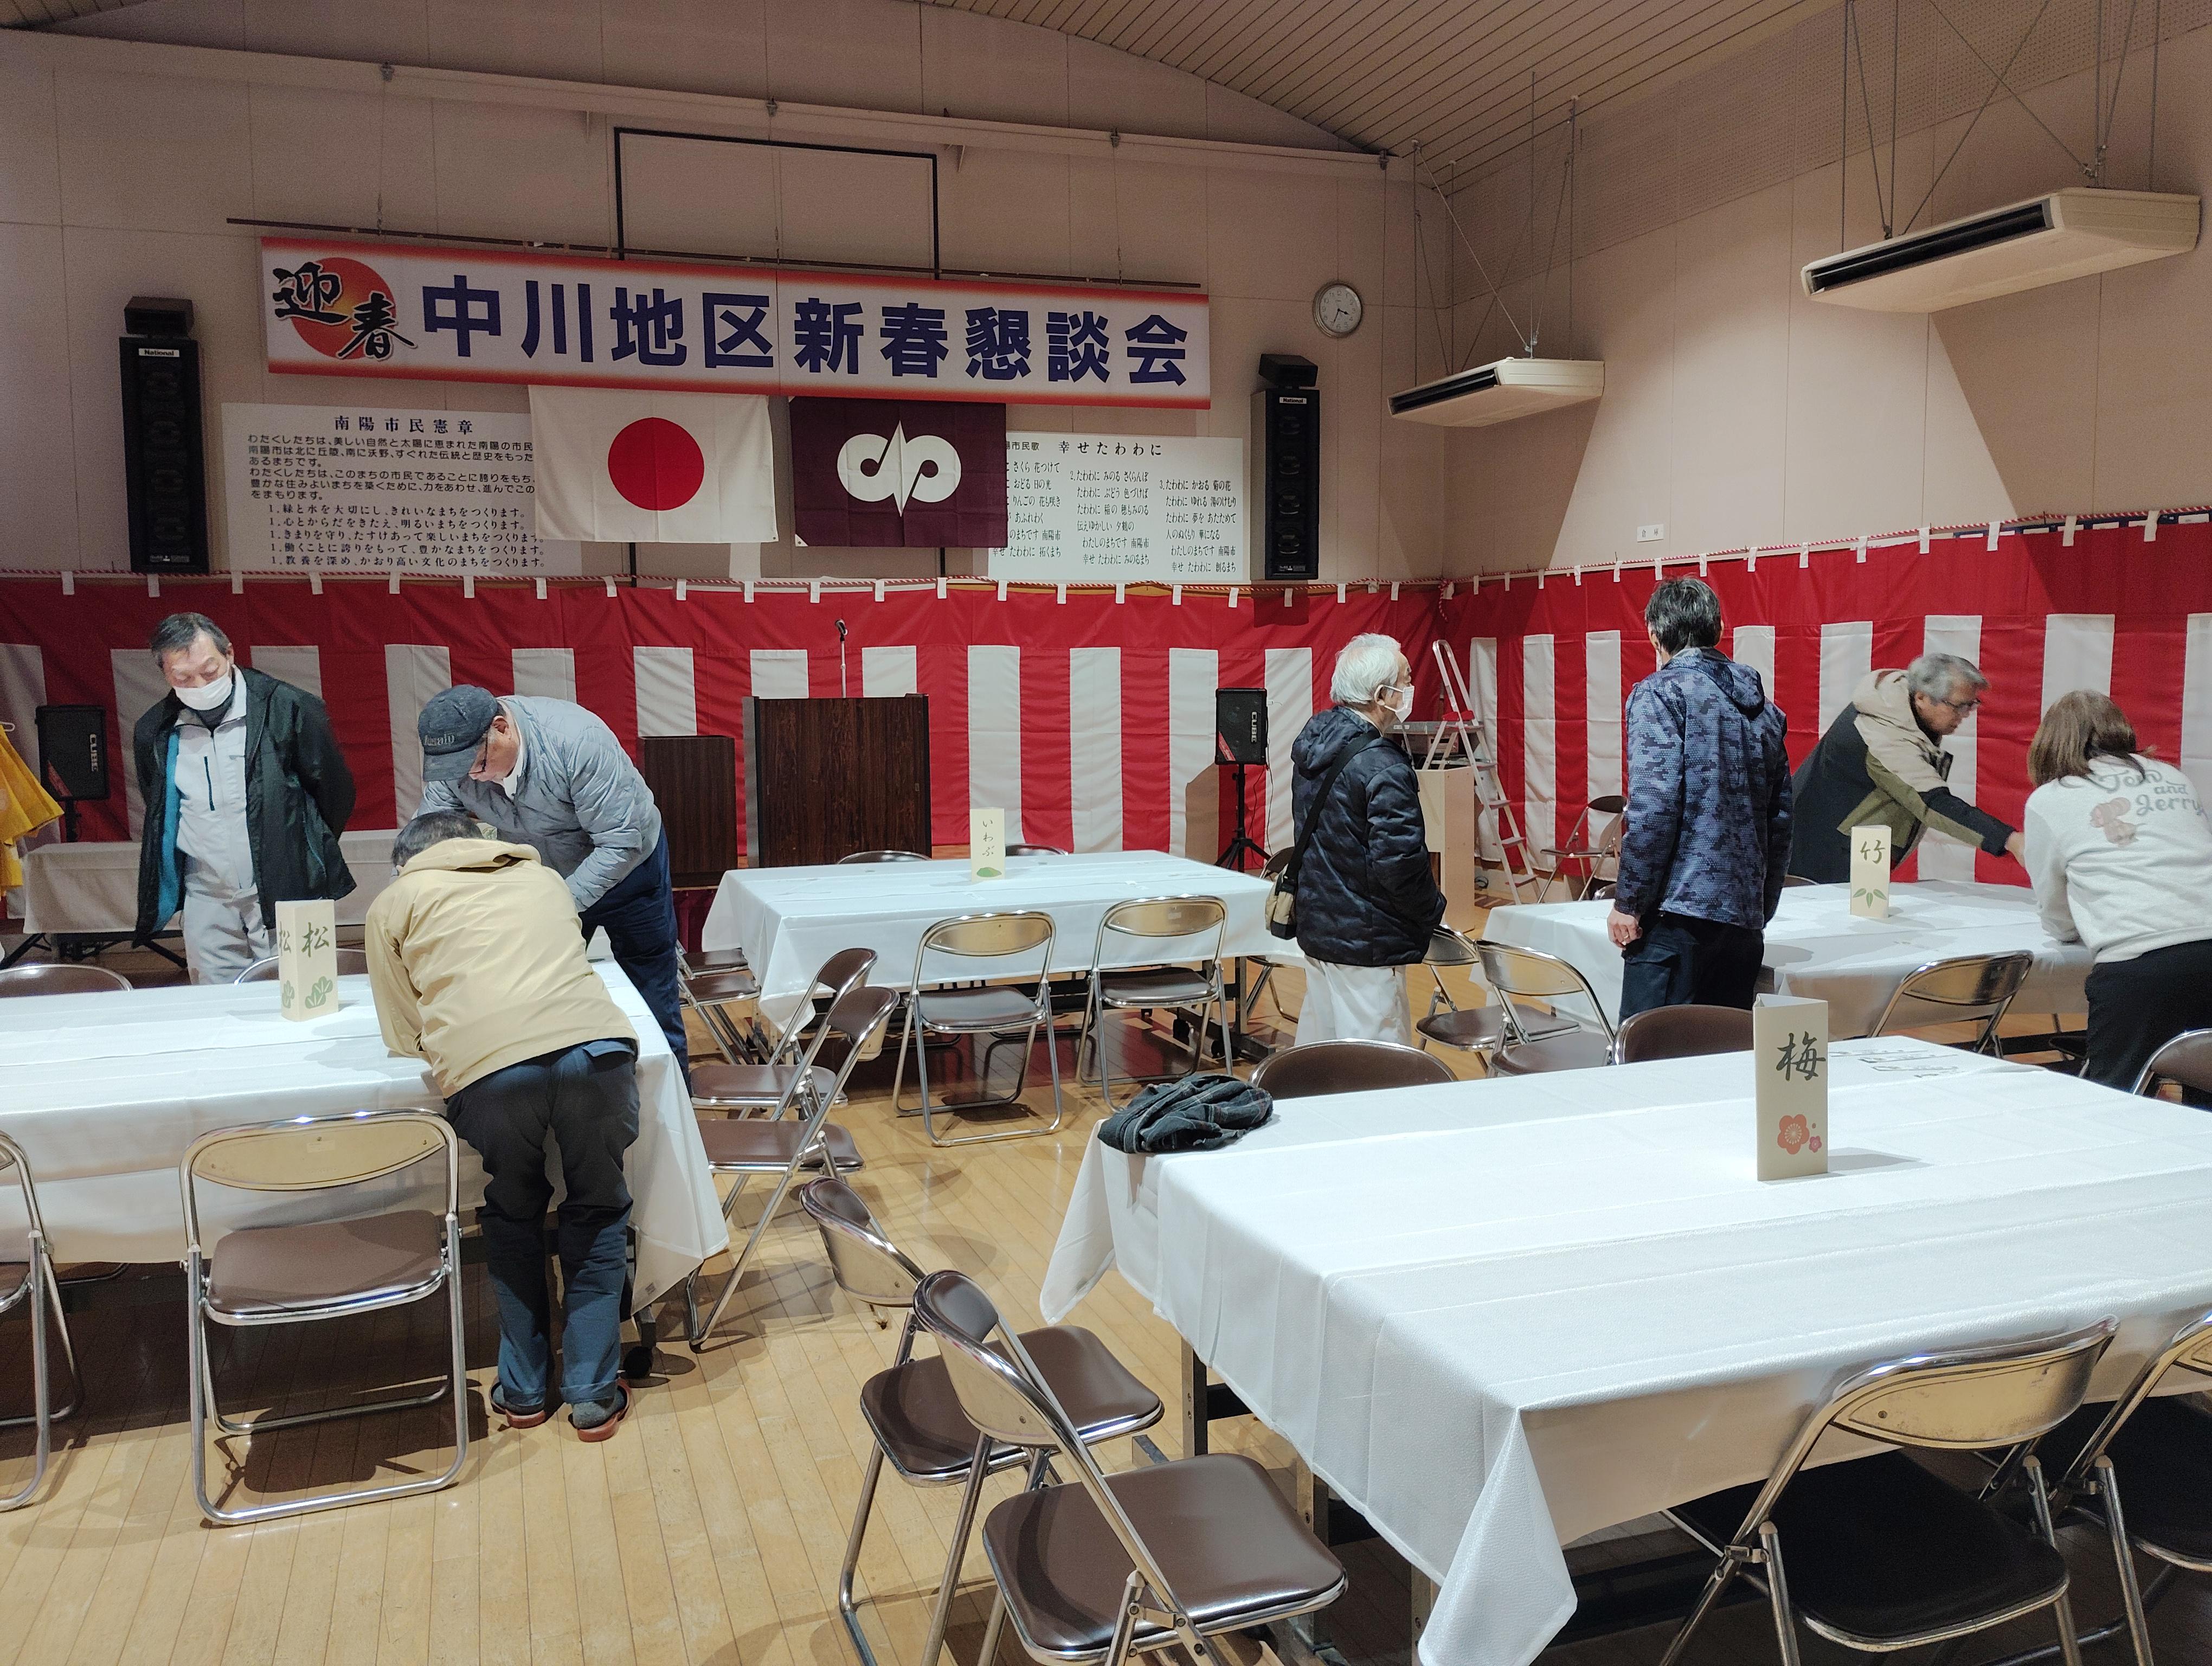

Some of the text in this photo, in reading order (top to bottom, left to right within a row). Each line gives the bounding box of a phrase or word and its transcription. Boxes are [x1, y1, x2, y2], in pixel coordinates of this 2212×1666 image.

[272, 261, 415, 359] 迎春
[422, 274, 1188, 387] 中川地区新春懇談会
[333, 415, 473, 434] 南陽市民憲章
[249, 457, 321, 467] あるまちです。
[1013, 461, 1030, 472] さくら
[1034, 462, 1060, 473] 花つけて
[1103, 471, 1120, 482] みのる
[1014, 478, 1031, 490] おどる
[1034, 479, 1052, 490] 日の光
[1192, 480, 1210, 491] かおる
[251, 490, 323, 501] をまもります。
[1077, 487, 1101, 498] たわわに
[1013, 495, 1036, 507] りんごの
[1166, 496, 1188, 507] たわわに
[1191, 496, 1207, 507] ゆれる
[1077, 503, 1101, 515] たわわに
[1015, 512, 1044, 524] あふれわく
[1166, 512, 1189, 523] たわわに
[1207, 512, 1237, 524] あたためて
[1042, 529, 1061, 541] 南陽市
[1082, 537, 1149, 548] わたしのまちです 南陽市
[1009, 546, 1036, 557] たわわに
[1171, 545, 1236, 556] わたしのまちです 南陽市
[1083, 554, 1149, 565] 幸せ たわわに みのるまち
[1172, 561, 1184, 573] 幸せ
[1188, 561, 1211, 573] たわわに
[90, 734, 98, 772] CUBE
[2154, 780, 2189, 795] and
[2136, 794, 2203, 817] Jerry
[982, 819, 995, 856] いわぶ
[1860, 840, 1886, 864] 竹
[279, 920, 292, 957] 松
[301, 922, 330, 958] 松
[1776, 1031, 1827, 1082] 梅
